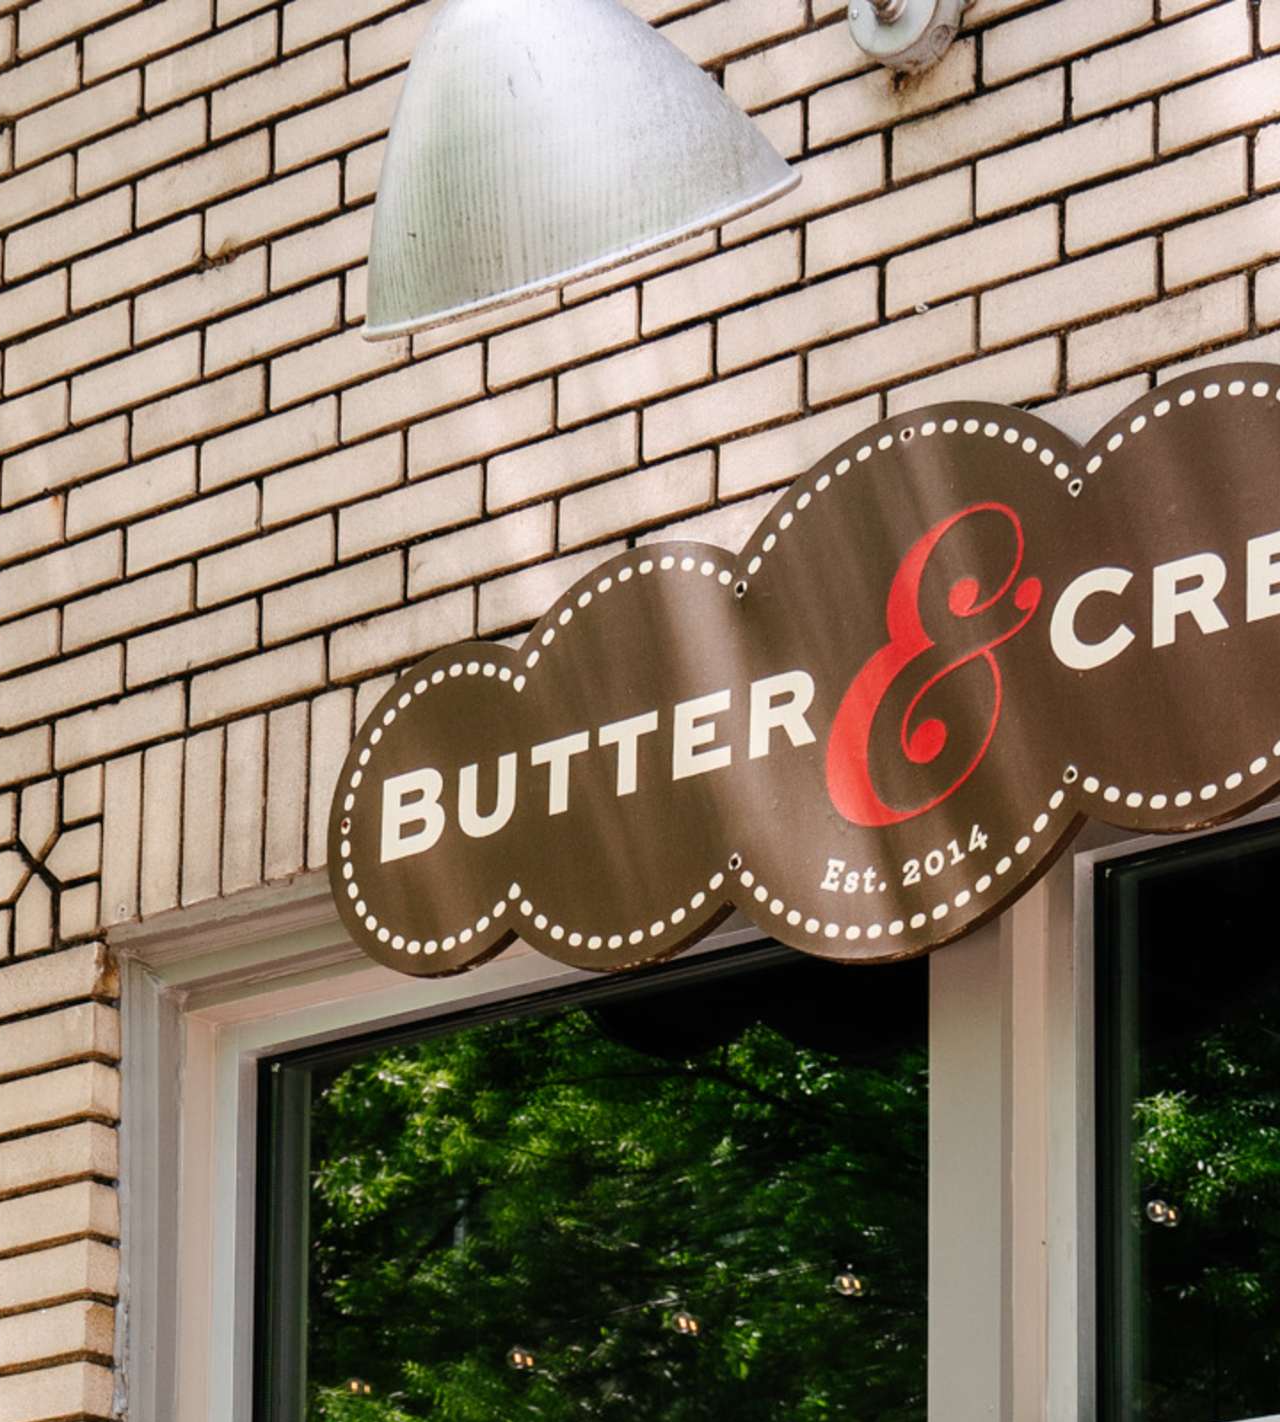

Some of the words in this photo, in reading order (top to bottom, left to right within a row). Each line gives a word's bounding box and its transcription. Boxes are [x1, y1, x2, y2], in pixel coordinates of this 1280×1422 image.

[378, 670, 815, 864] BUTTER
[826, 501, 1043, 827] &
[820, 858, 887, 894] Est.
[902, 823, 989, 887] 2014
